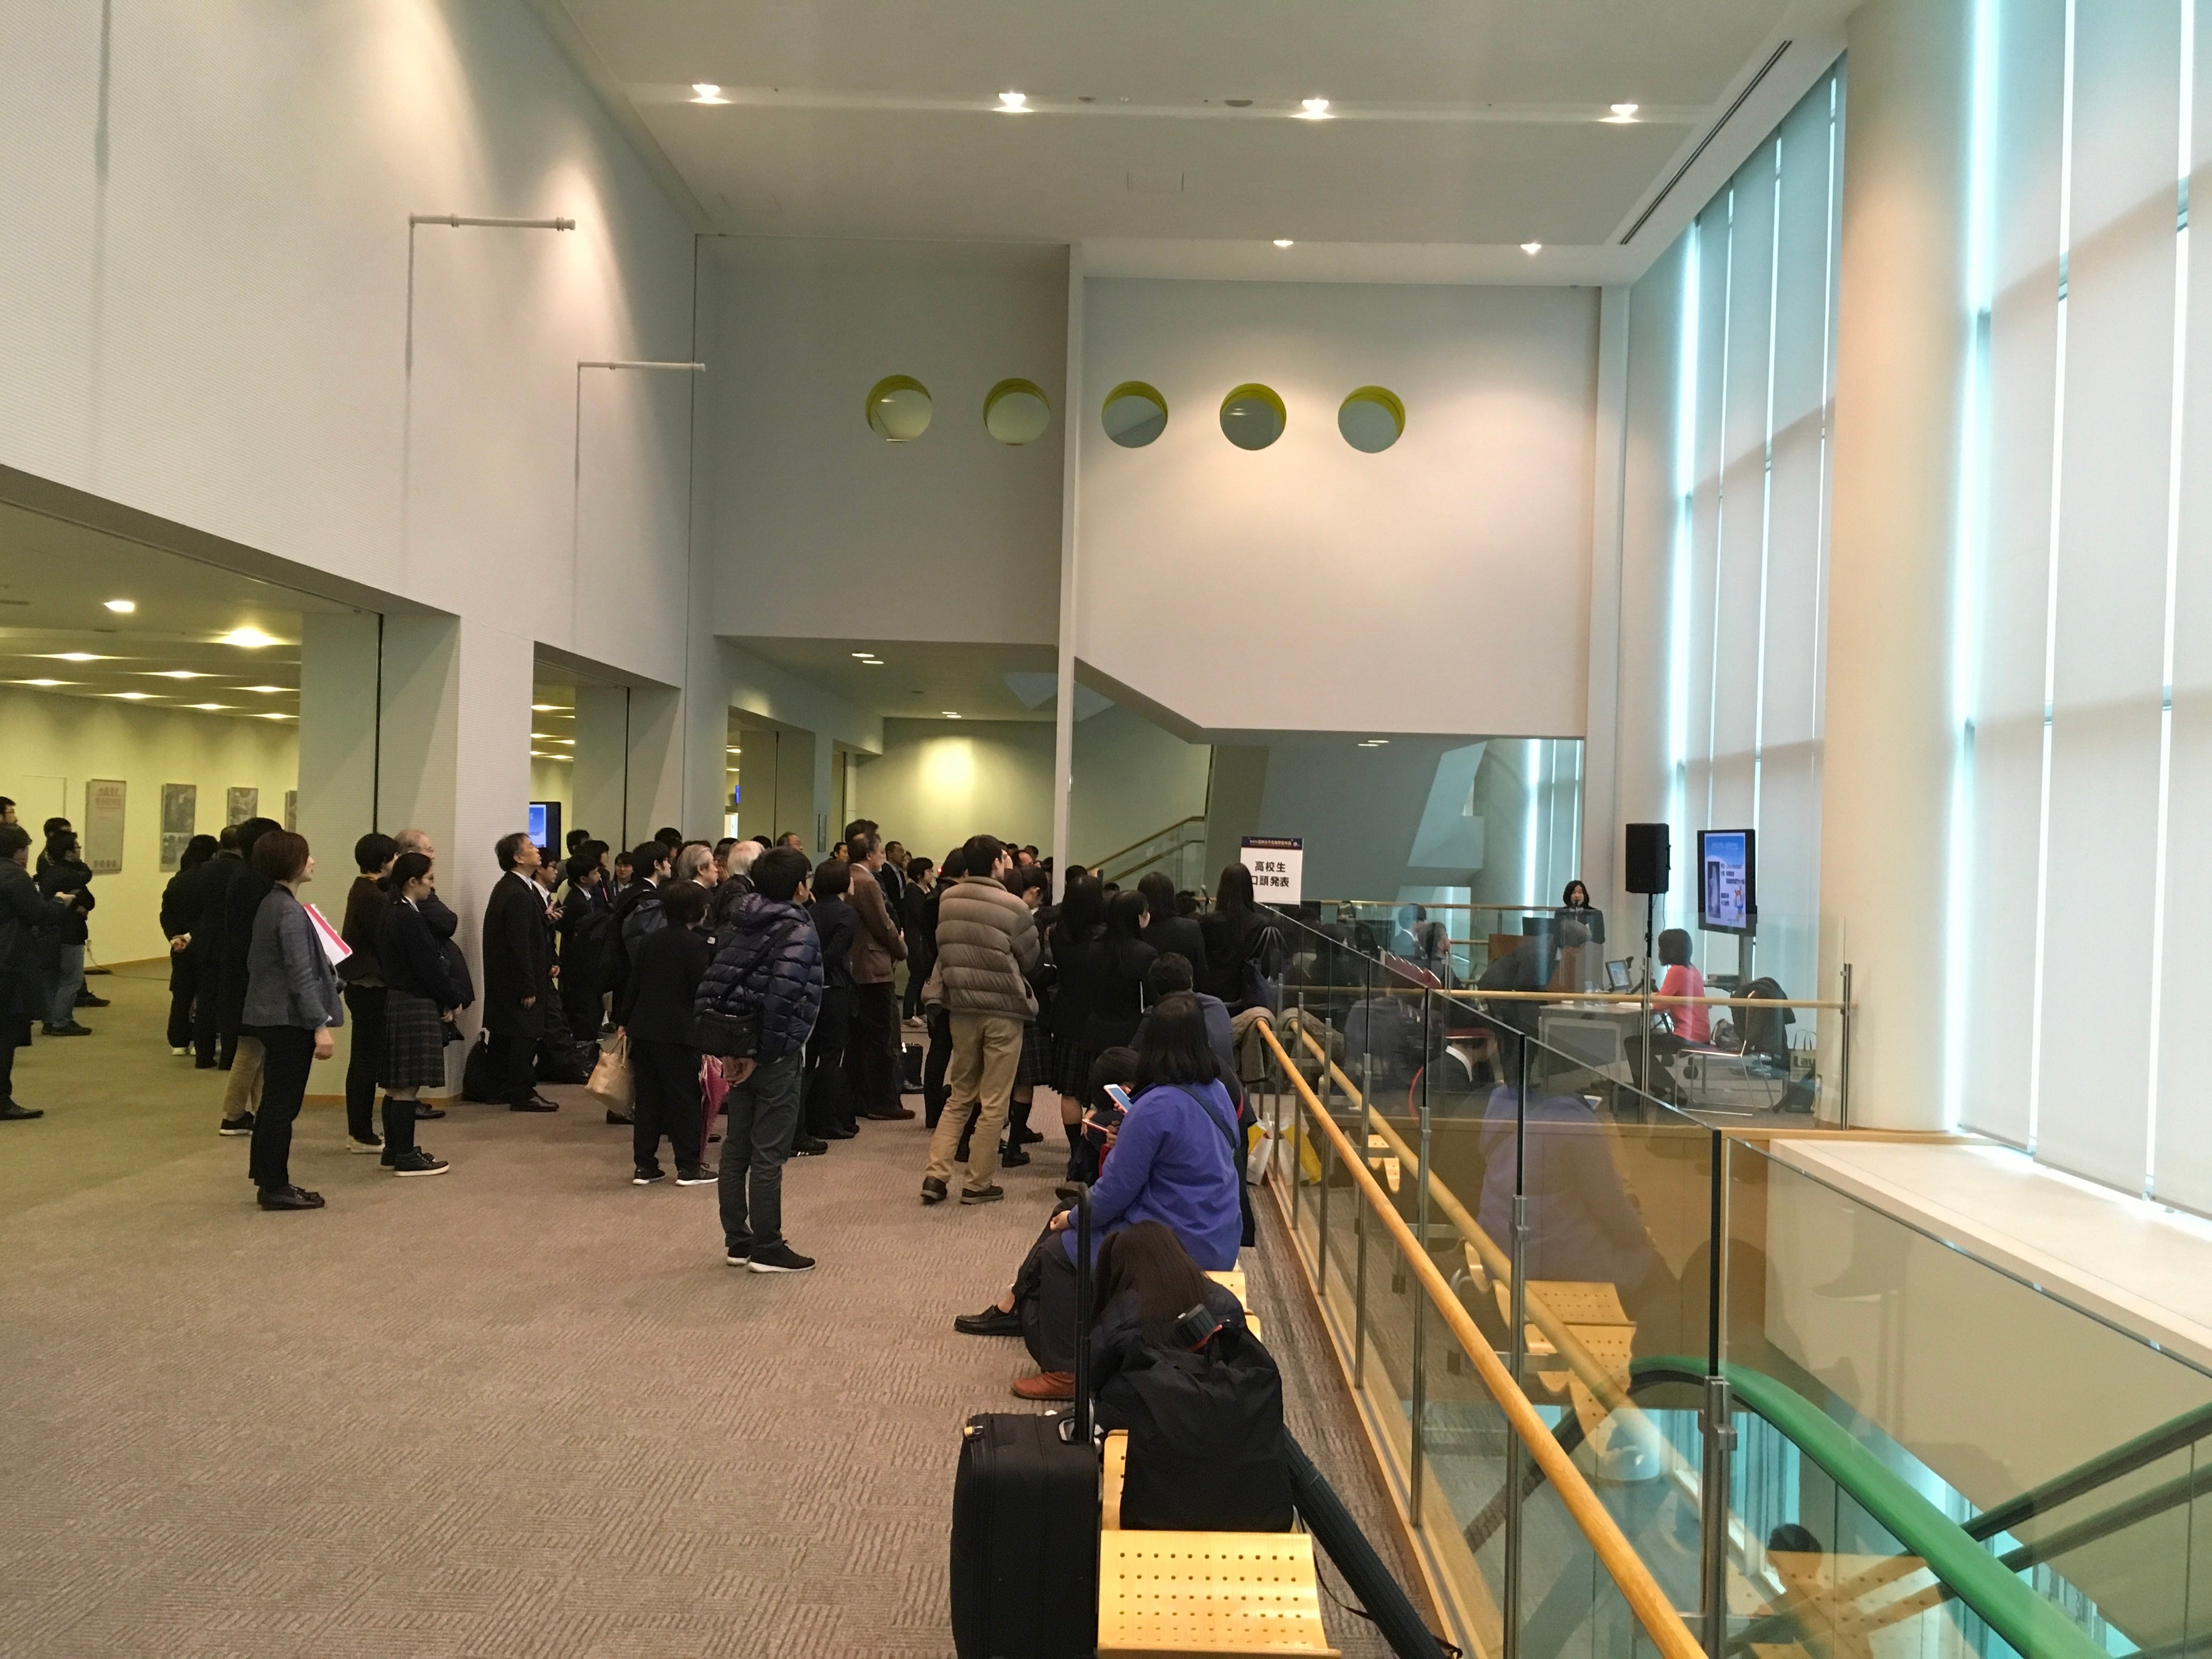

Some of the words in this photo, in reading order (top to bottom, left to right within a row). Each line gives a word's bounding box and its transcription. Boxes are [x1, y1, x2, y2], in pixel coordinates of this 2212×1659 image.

[1255, 861, 1286, 872] 高校生
[1251, 875, 1289, 887] 口頭発表
